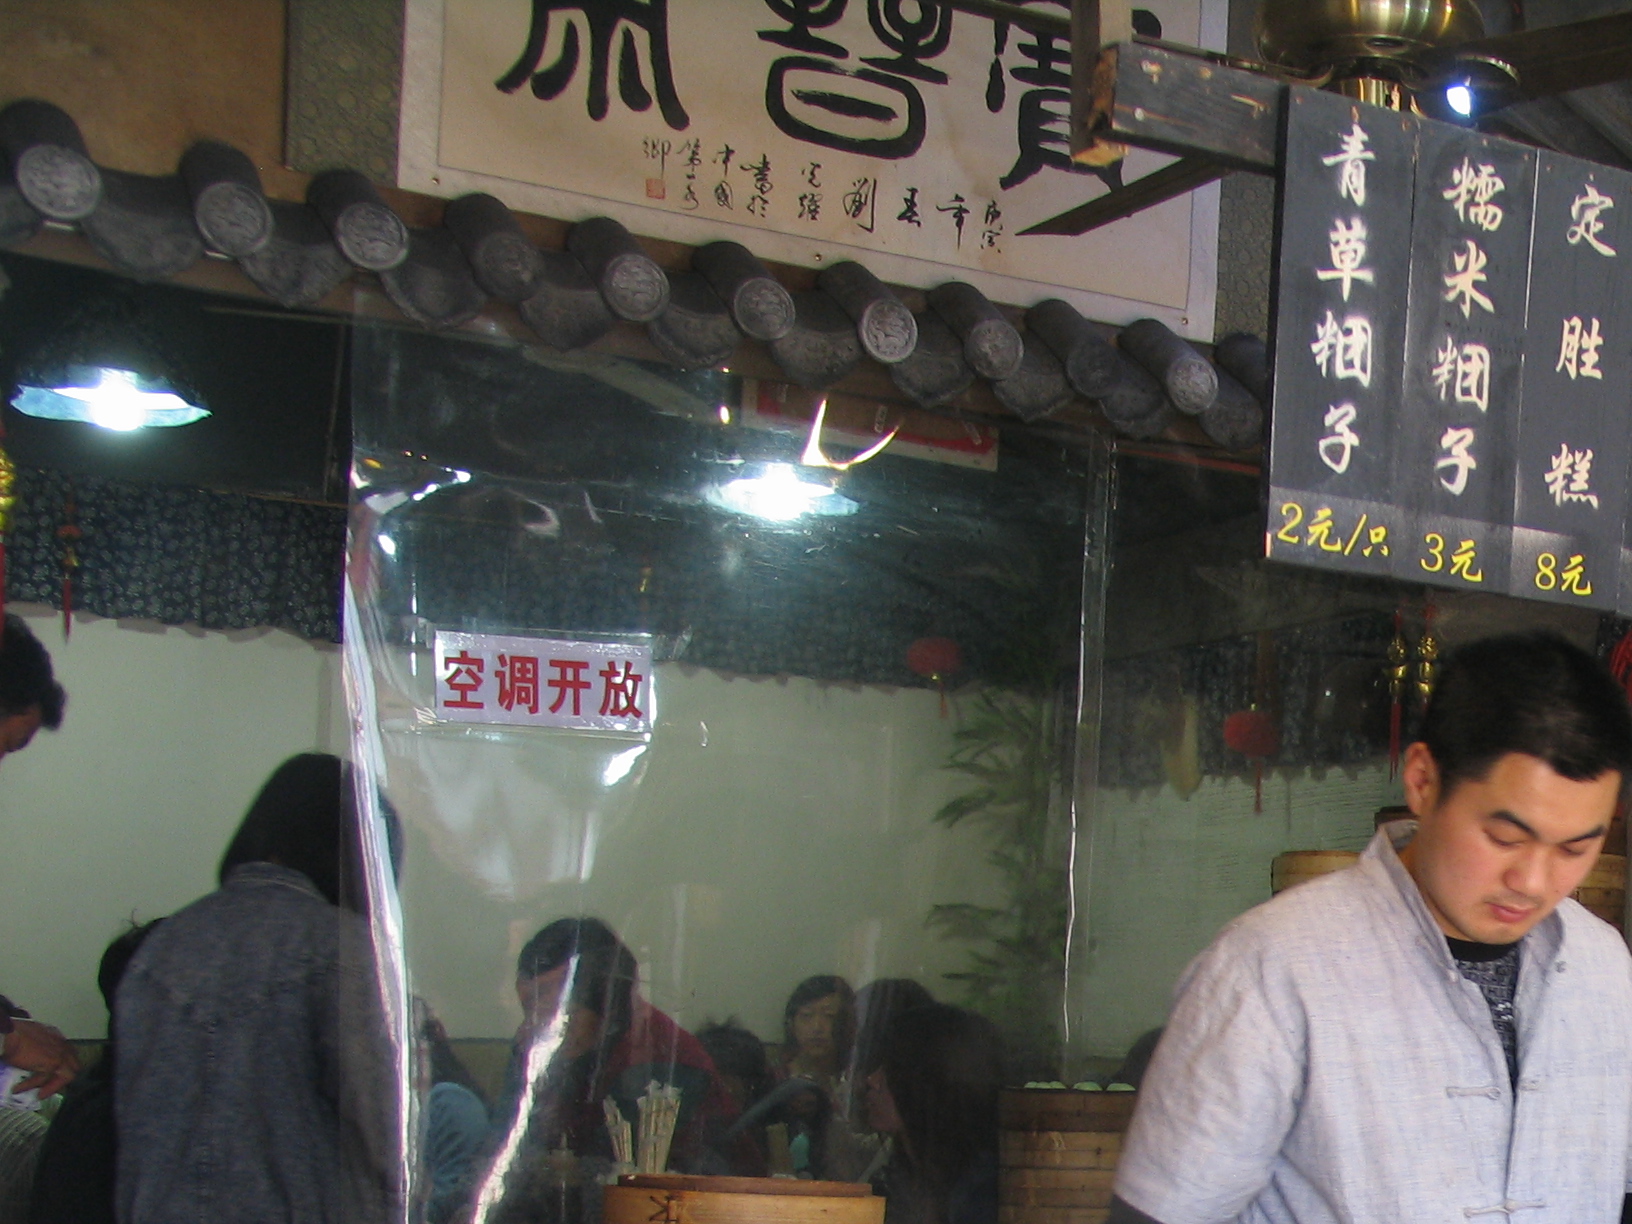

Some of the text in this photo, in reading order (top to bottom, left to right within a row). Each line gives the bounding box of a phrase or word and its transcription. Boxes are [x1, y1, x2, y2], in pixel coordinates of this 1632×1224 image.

[1544, 184, 1617, 510] 定胜糕
[1277, 501, 1389, 559] 2元/只
[1420, 532, 1483, 582] 3元
[1534, 553, 1593, 596] 8元
[444, 651, 643, 719] 空调开放
